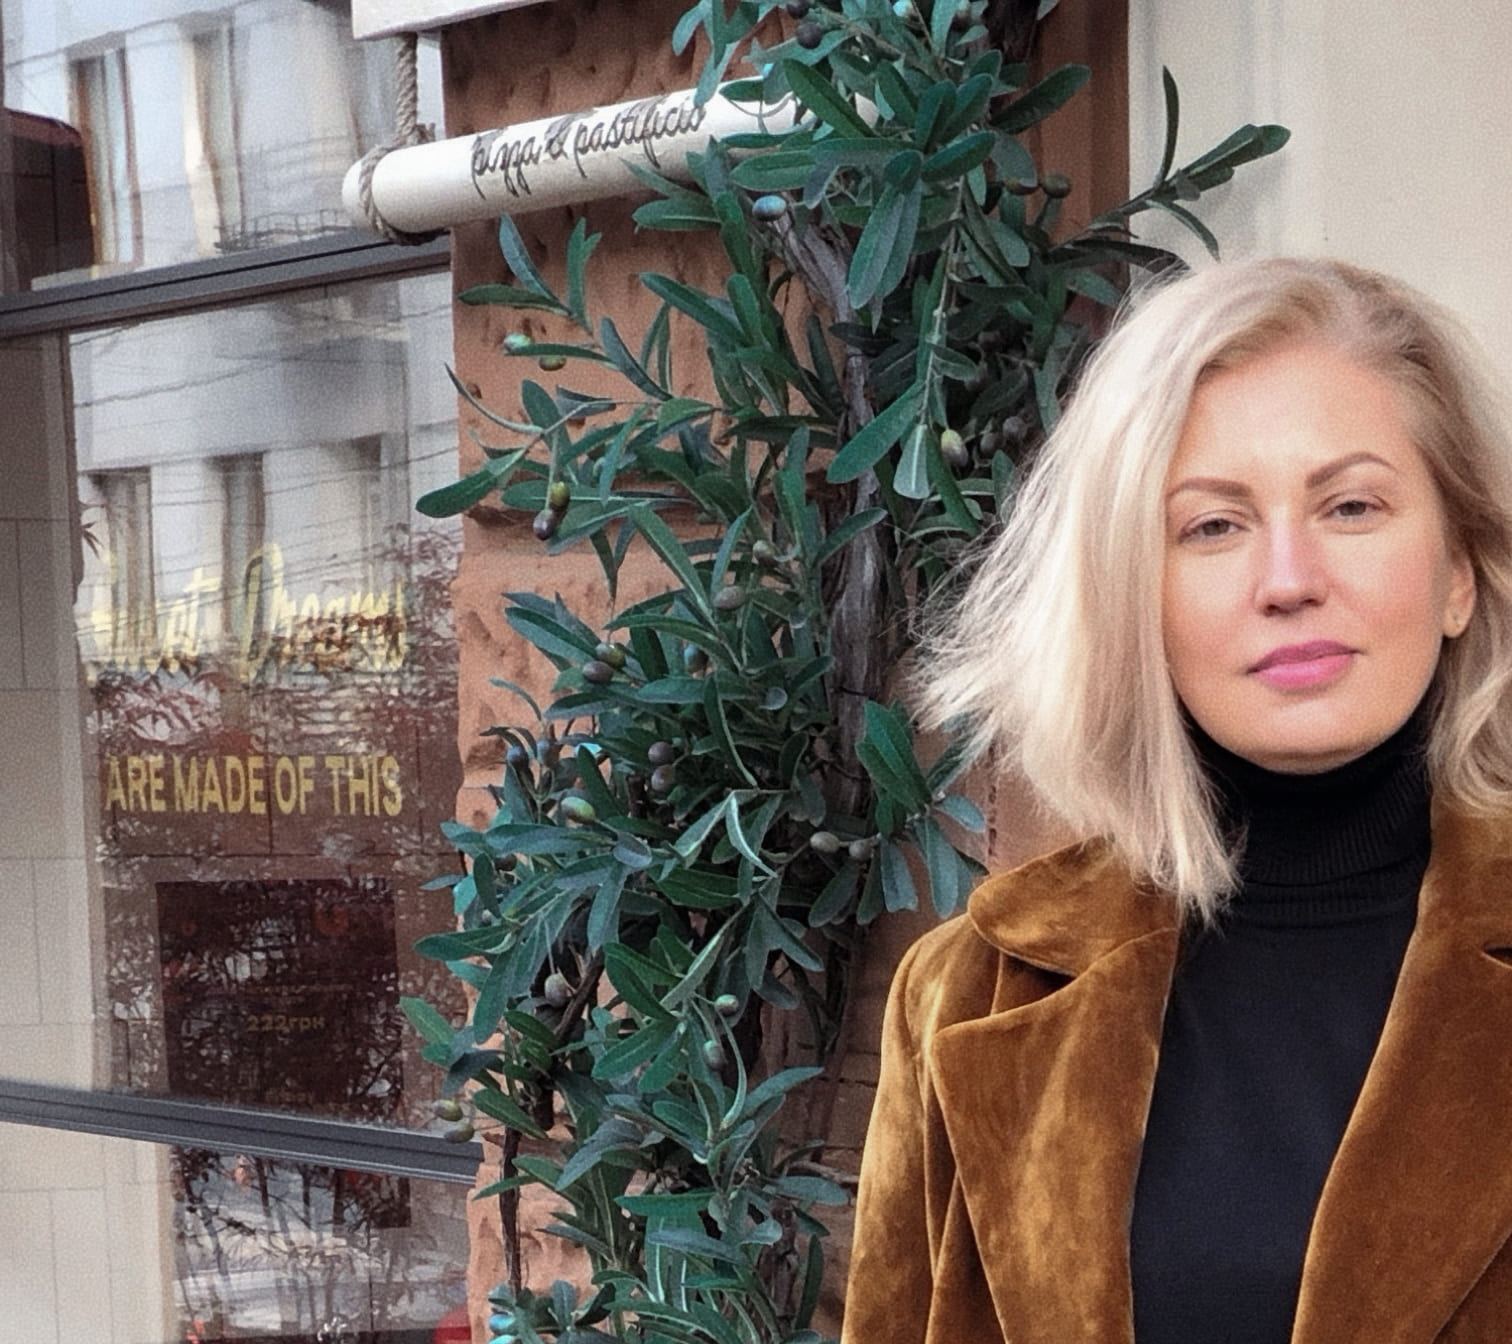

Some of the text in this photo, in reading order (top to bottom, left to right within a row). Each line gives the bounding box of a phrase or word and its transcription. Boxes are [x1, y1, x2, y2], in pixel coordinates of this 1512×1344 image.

[471, 130, 543, 200] pizza
[572, 95, 706, 180] pastificio
[105, 754, 403, 816] ARE MADE OF THIS
